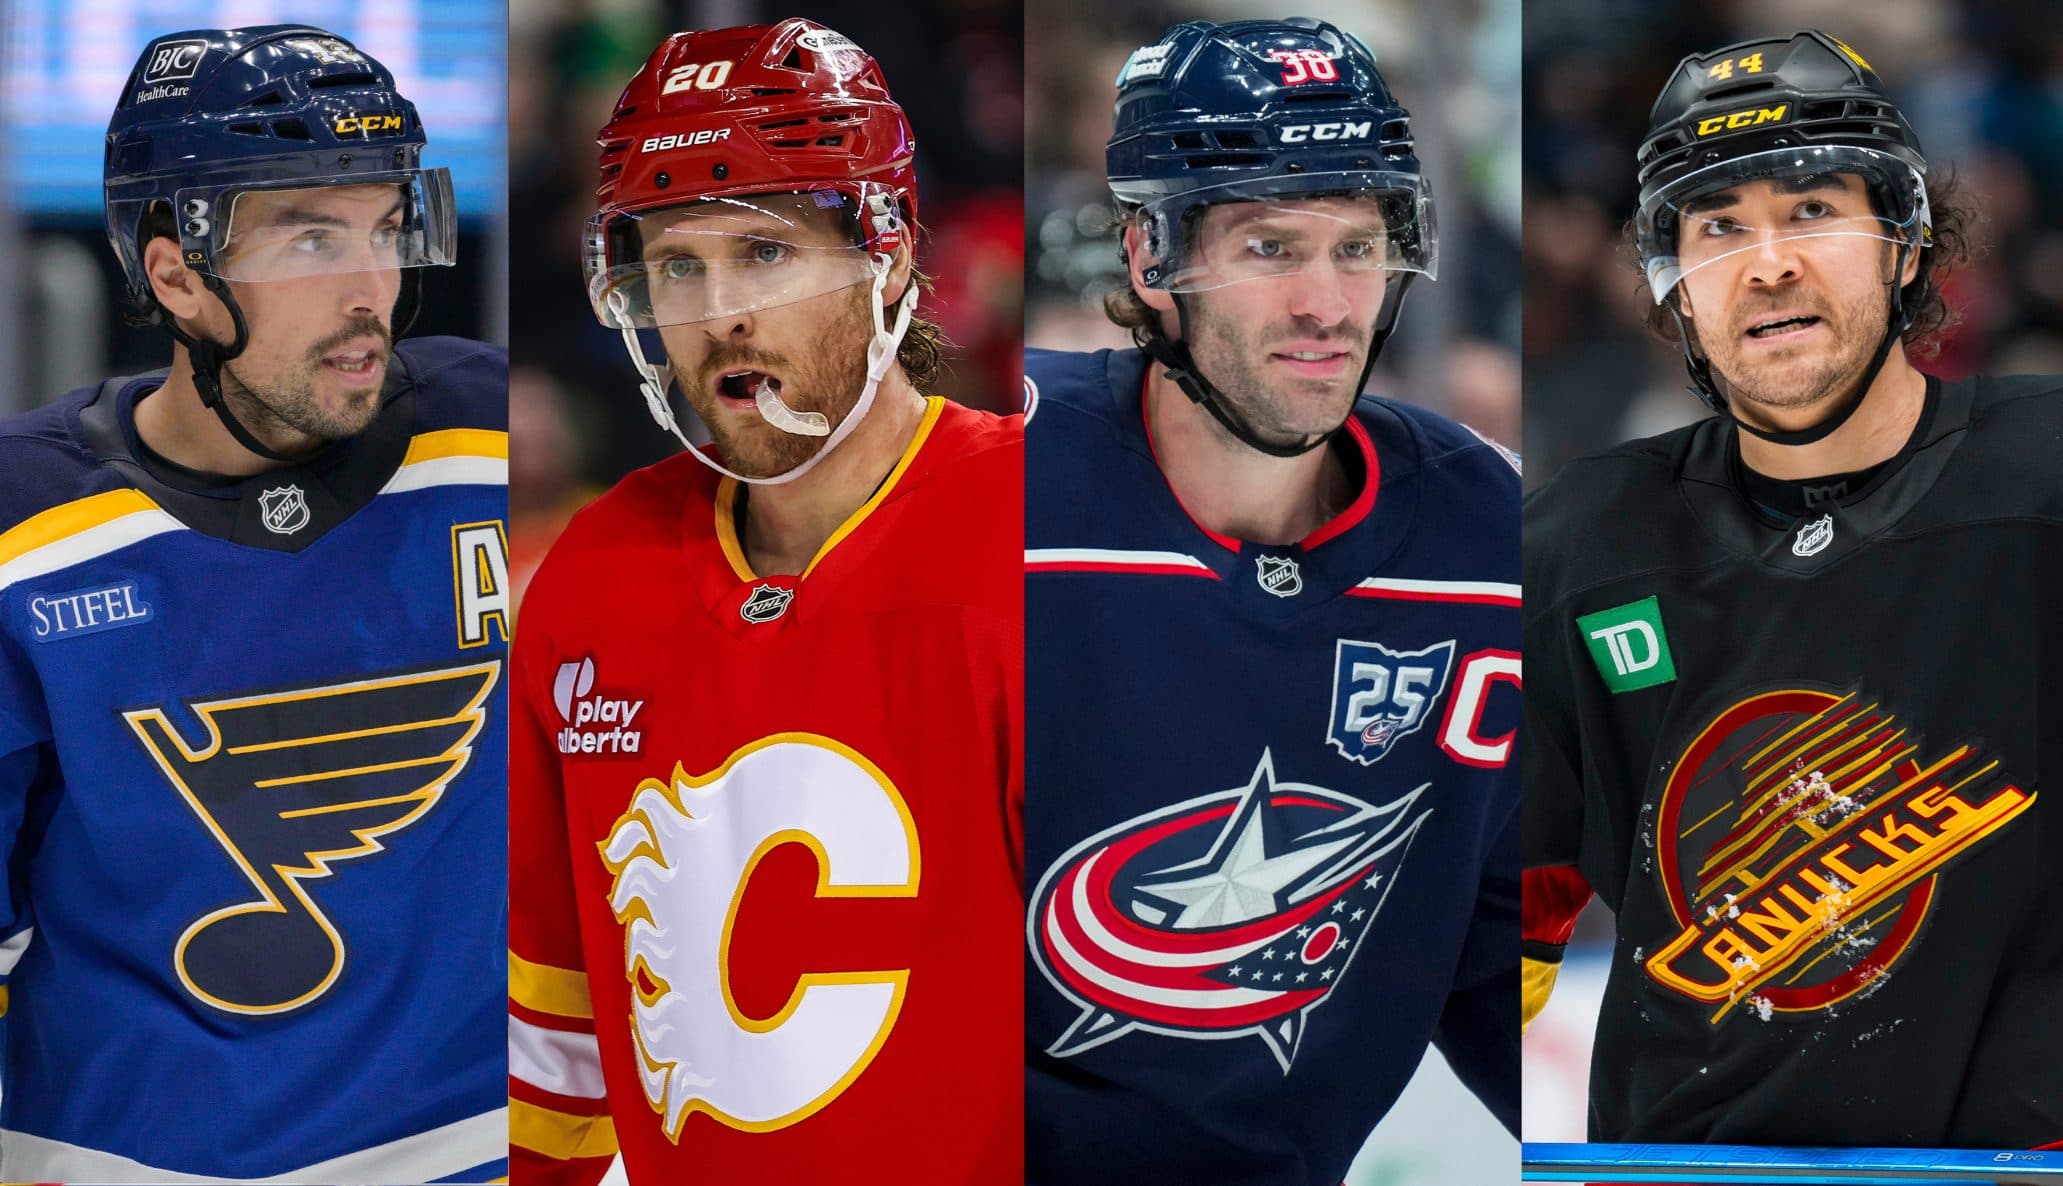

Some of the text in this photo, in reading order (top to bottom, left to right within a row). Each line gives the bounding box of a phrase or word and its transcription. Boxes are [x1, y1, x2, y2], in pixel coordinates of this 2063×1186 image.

[150, 45, 202, 76] BJC
[1707, 52, 1764, 81] 44
[661, 60, 733, 96] 20
[136, 84, 190, 105] HealthCare
[335, 115, 402, 133] CCM
[1280, 121, 1373, 143] CCM
[1697, 104, 1787, 136] CCM
[641, 127, 731, 153] BAUER
[273, 498, 298, 526] NHL
[1801, 527, 1828, 552] NHL
[451, 519, 509, 649] A
[1267, 568, 1291, 587] NHL
[31, 586, 147, 635] STIFEL
[749, 598, 783, 614] NHL
[1590, 620, 1660, 676] TD
[575, 695, 644, 728] play
[1344, 661, 1434, 732] 25
[1437, 648, 1522, 768] C
[557, 726, 641, 753] alberta
[1645, 784, 2034, 1003] CANUCKS
